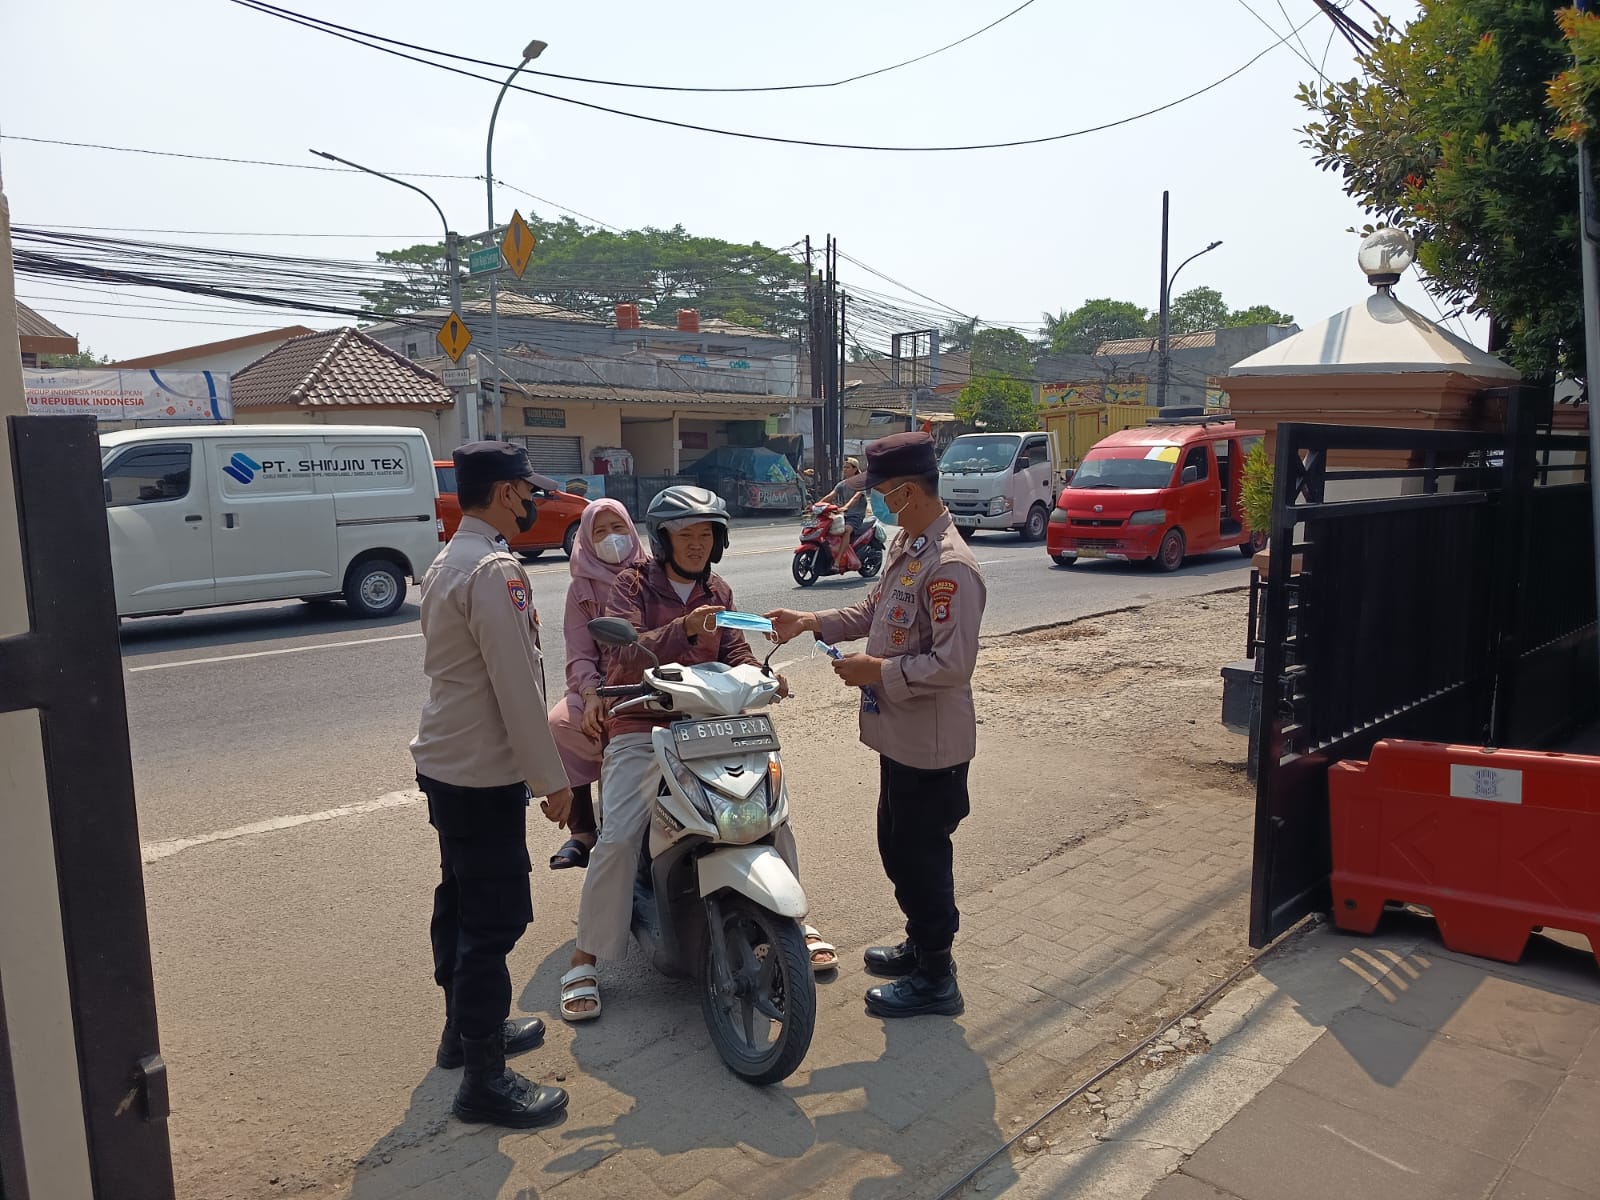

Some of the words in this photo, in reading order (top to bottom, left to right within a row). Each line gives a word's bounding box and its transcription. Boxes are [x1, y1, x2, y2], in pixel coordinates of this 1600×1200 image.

[41, 398, 90, 406] REPUBLIK
[93, 398, 144, 406] INDONESIA
[262, 461, 291, 473] PT.
[298, 459, 365, 472] SHINJIN
[370, 458, 404, 470] TEX
[891, 589, 915, 604] POLRI
[680, 728, 690, 741] B
[697, 722, 734, 738] 6109
[656, 805, 678, 829] HONDA
